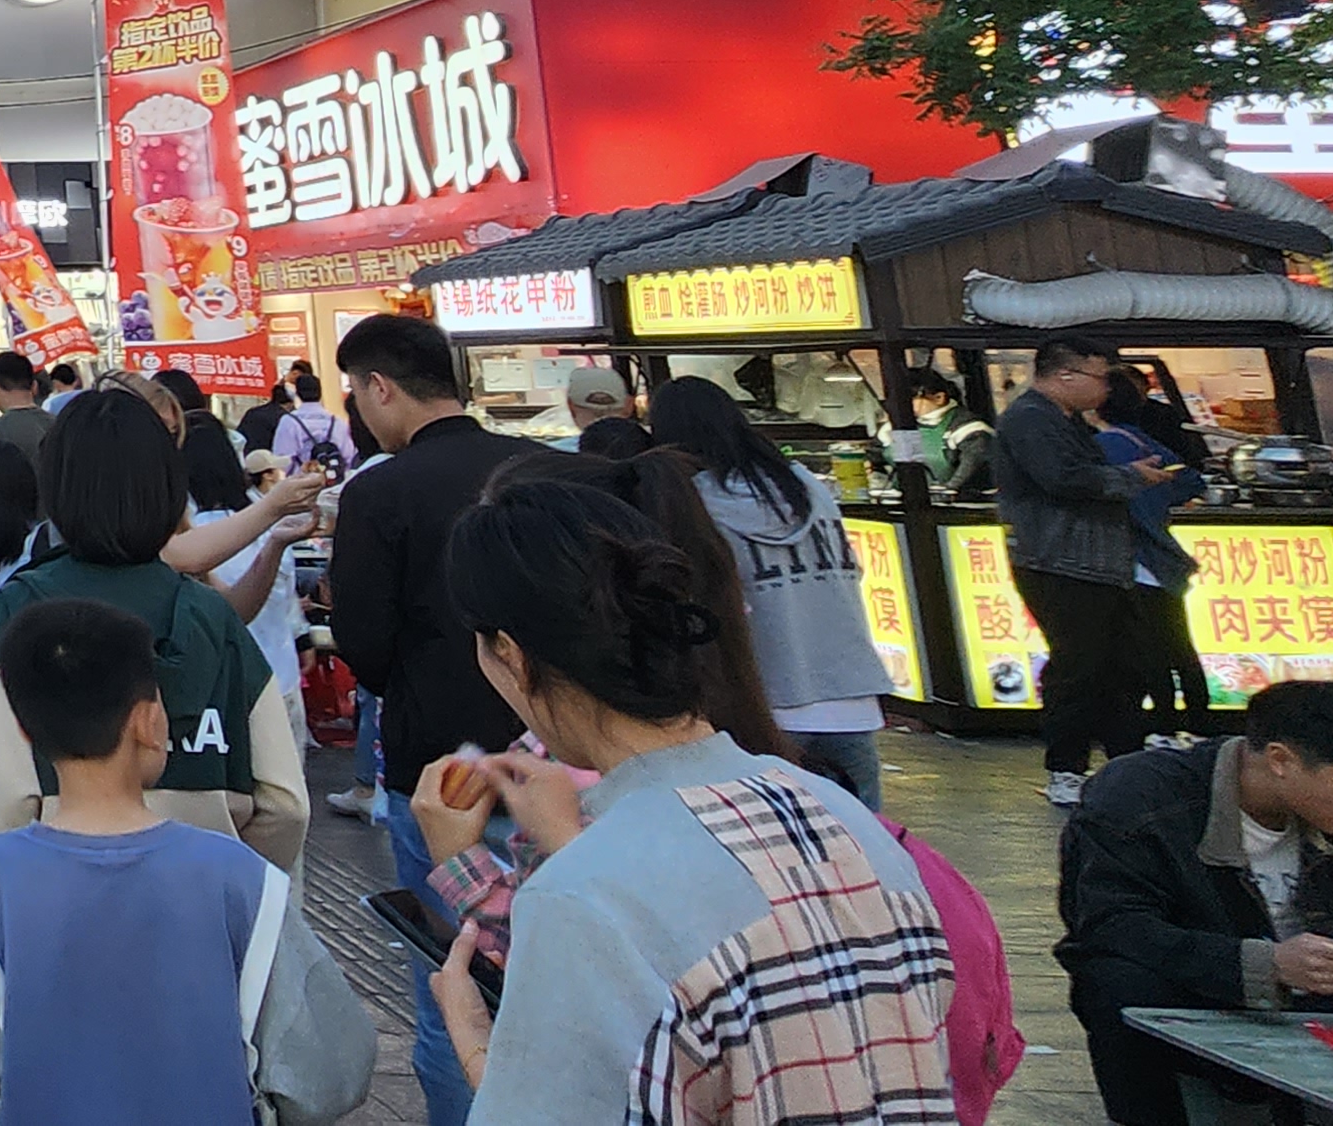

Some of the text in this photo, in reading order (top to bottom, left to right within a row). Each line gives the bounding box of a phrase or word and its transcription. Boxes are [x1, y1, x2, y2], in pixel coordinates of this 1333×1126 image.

[121, 5, 213, 47] 指定饮品
[112, 30, 221, 74] 第2杯半价
[235, 10, 529, 230] 蜜雪冰城
[168, 353, 265, 377] 蜜雪冰城
[1193, 536, 1329, 586] 肉炒河粉
